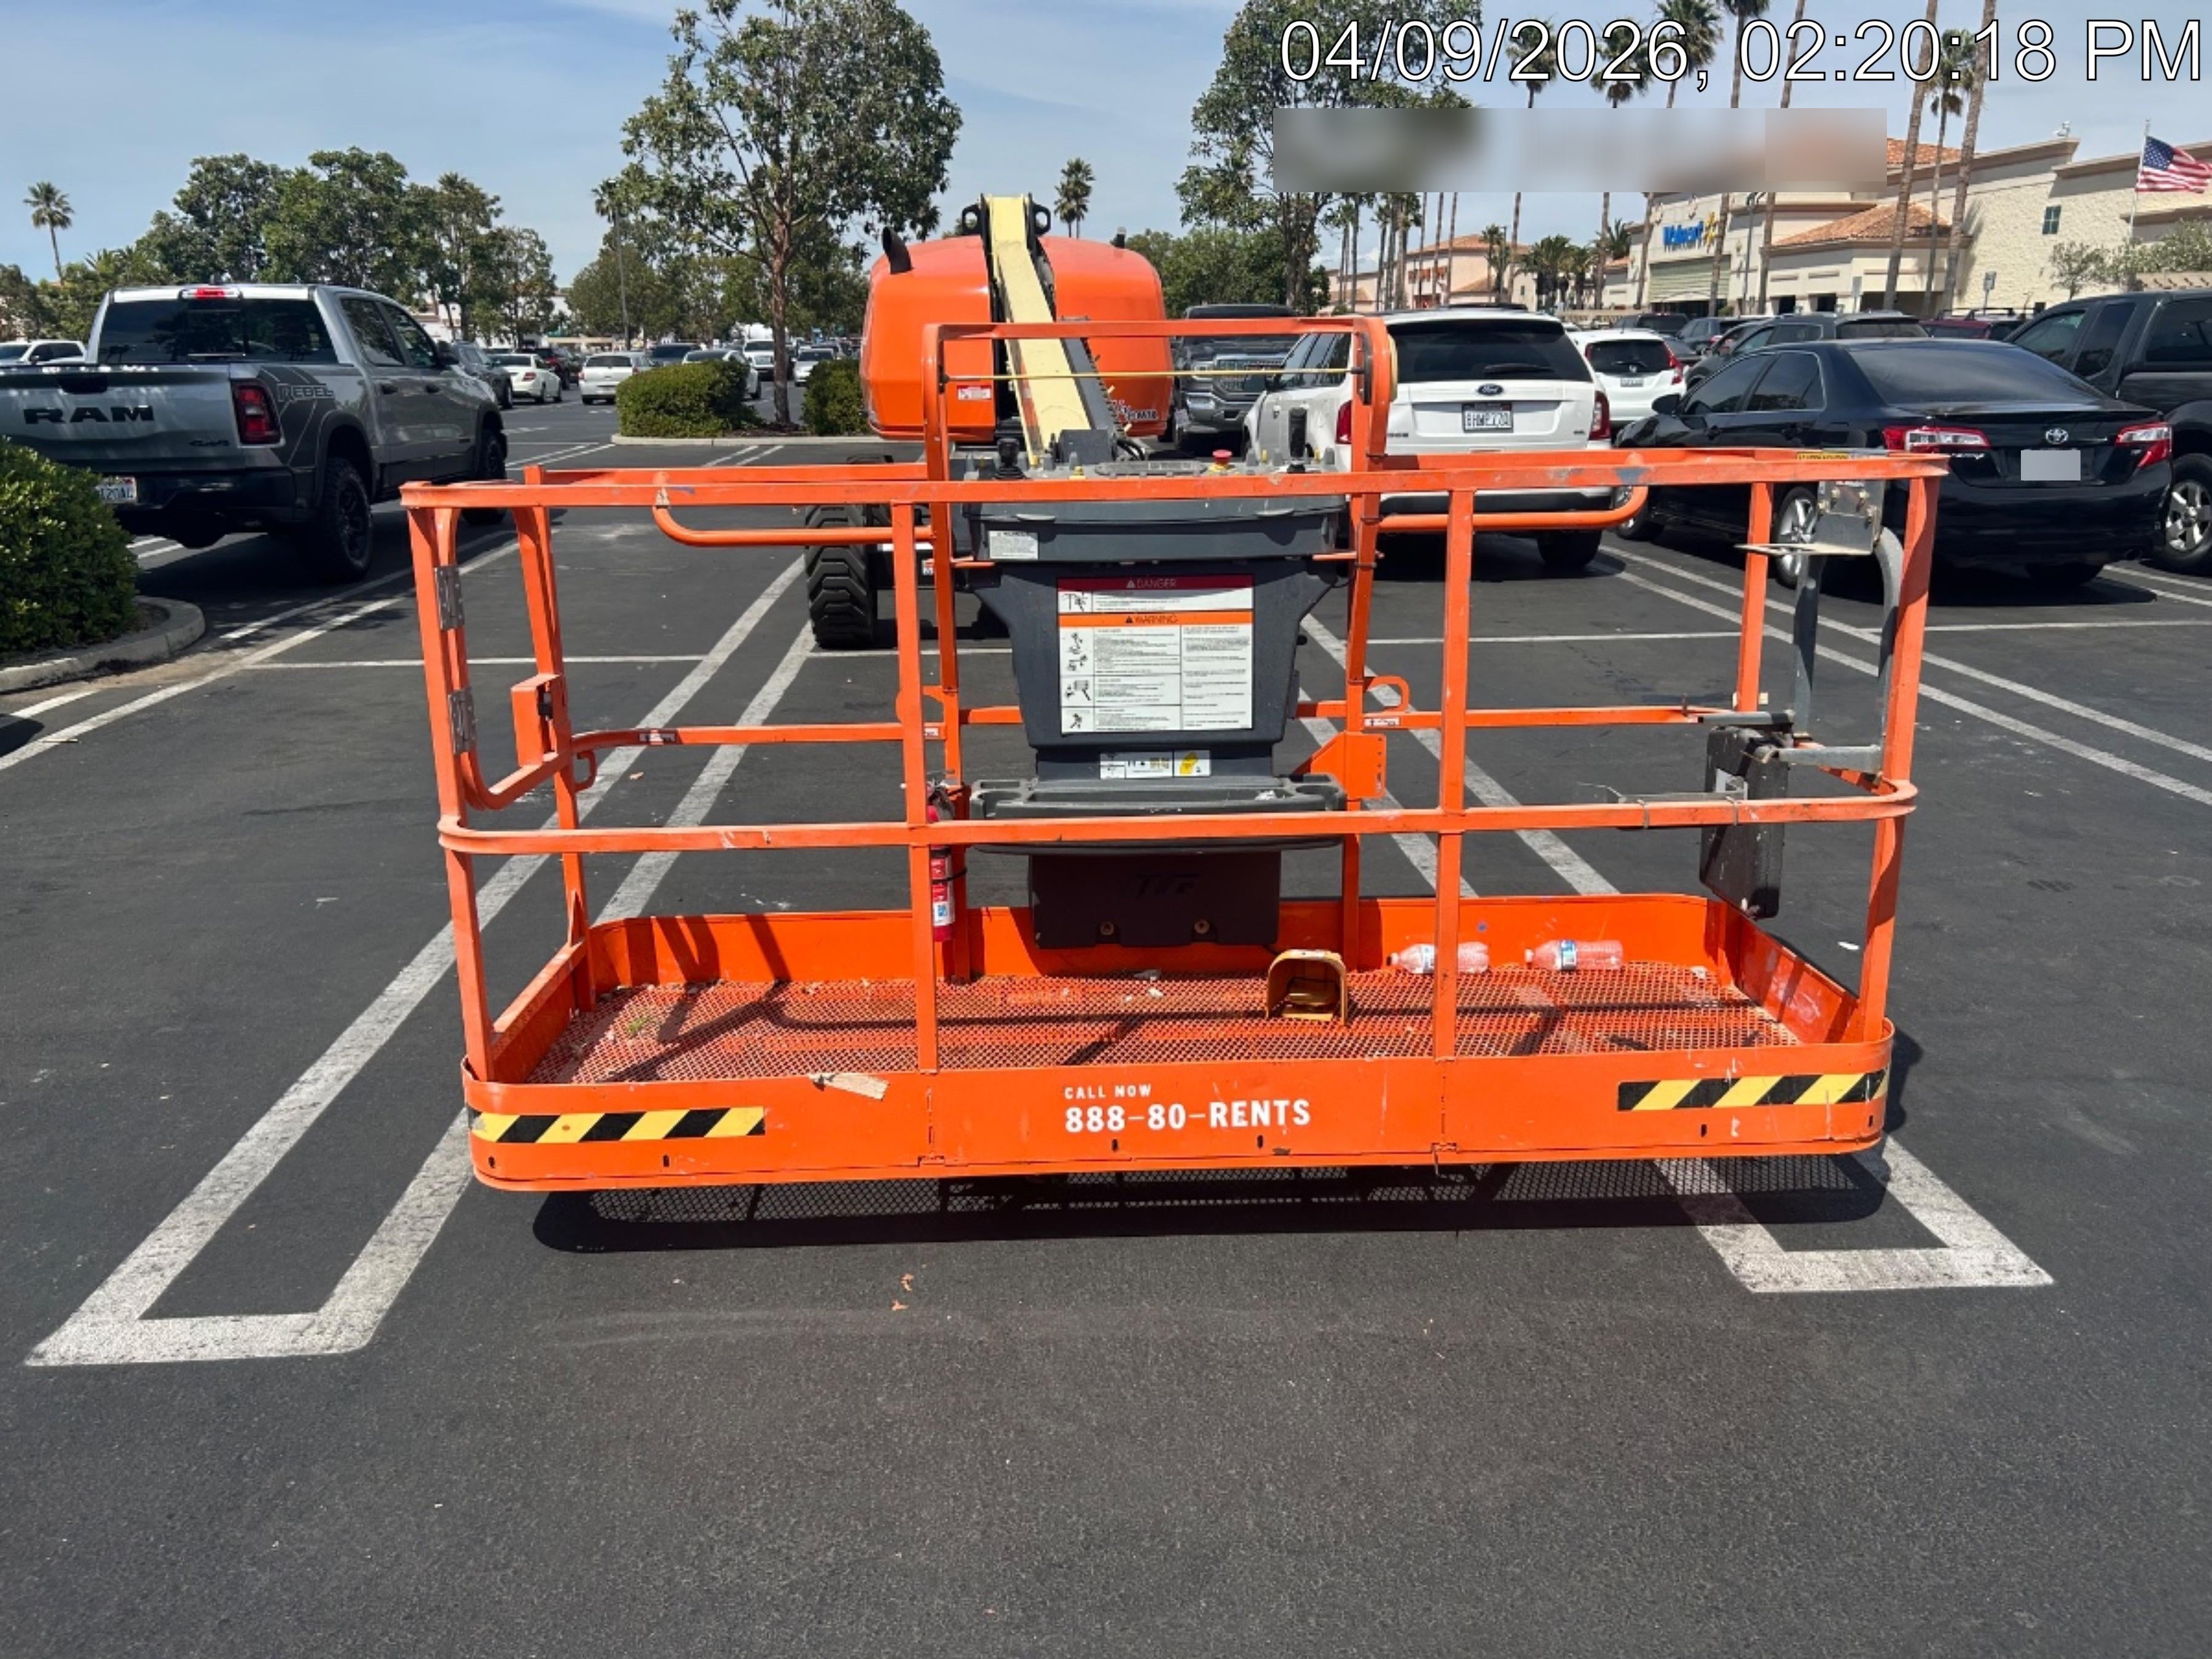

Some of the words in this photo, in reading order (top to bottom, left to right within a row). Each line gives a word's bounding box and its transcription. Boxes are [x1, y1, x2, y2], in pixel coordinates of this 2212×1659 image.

[276, 382, 335, 402] REBEL
[23, 406, 155, 424] RAM
[1137, 579, 1177, 589] DANGER
[1135, 614, 1178, 624] WARNING
[1064, 1086, 1106, 1100] CALL
[1115, 1084, 1151, 1097] NOW
[1064, 1099, 1311, 1133] 888-80-RENTS
